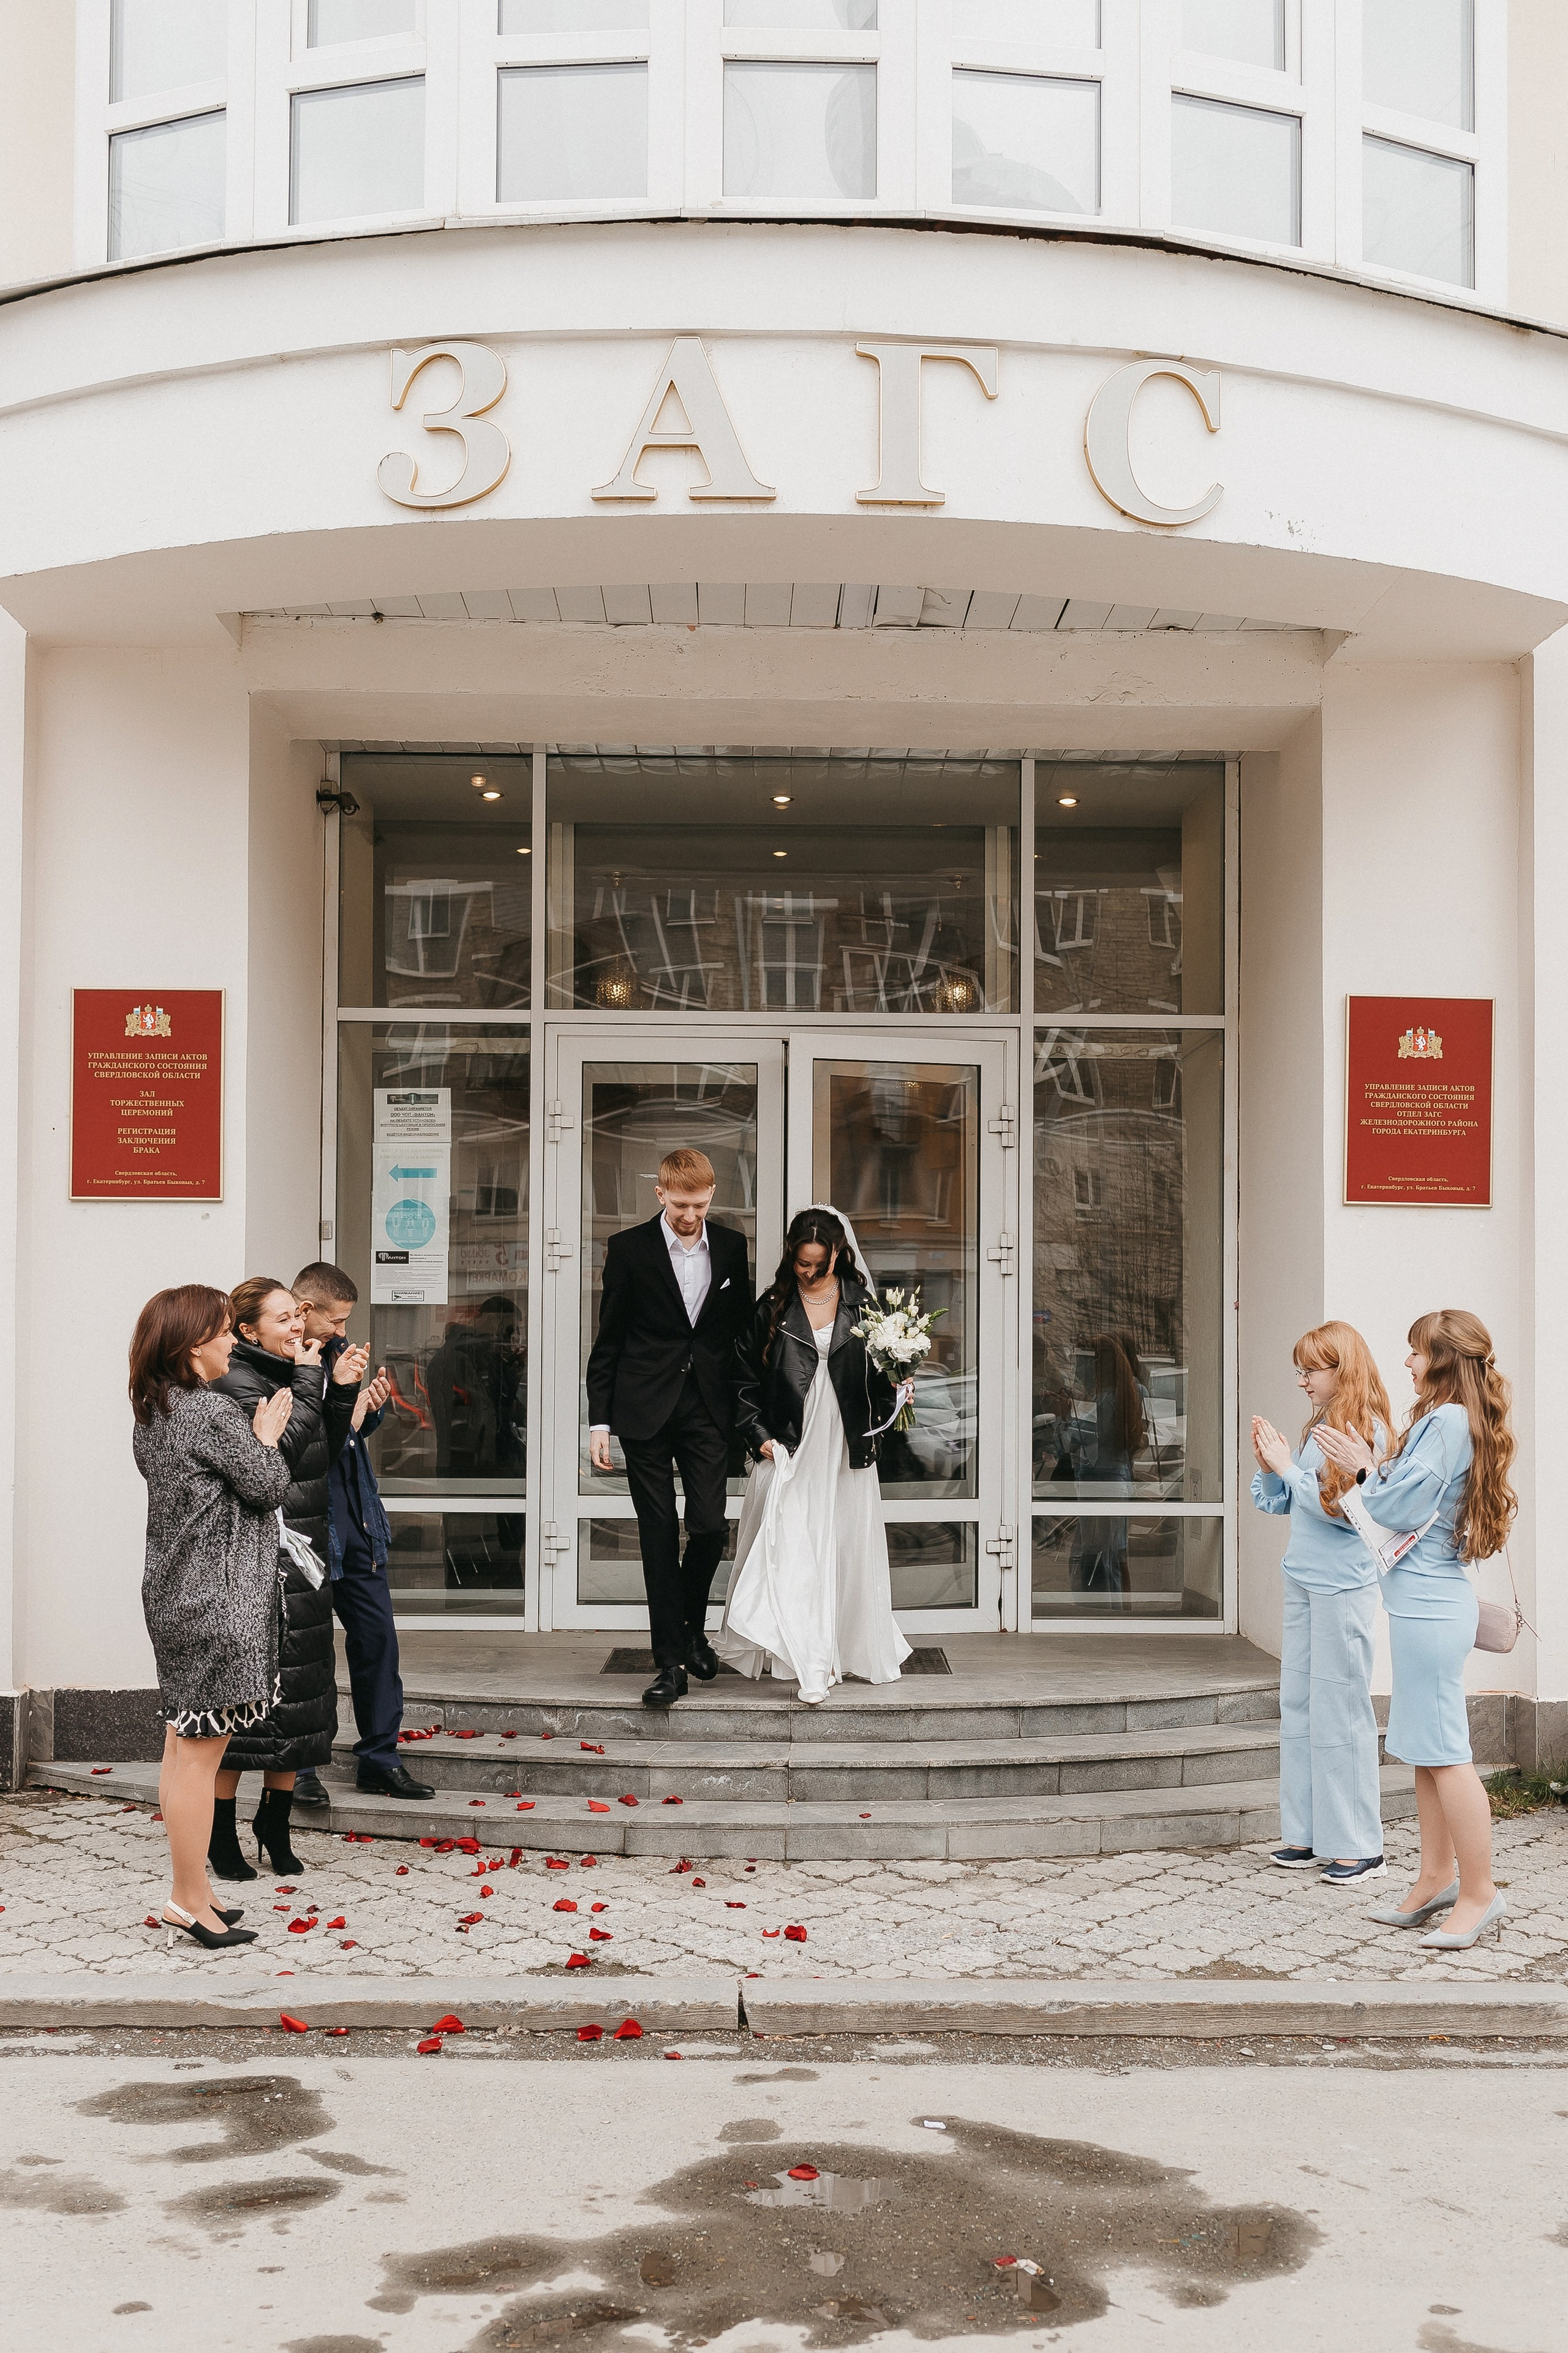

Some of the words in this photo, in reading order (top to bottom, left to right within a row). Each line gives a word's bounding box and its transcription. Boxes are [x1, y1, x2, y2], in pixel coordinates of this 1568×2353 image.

[376, 336, 1224, 527] ЗАГС
[94, 1070, 160, 1079] СВЕРДЛОВСКОЙ
[1370, 1100, 1431, 1109] СВЕРДЛОВСКОЙ
[121, 1108, 173, 1117] ЦЕРЕМОНИЙ
[1447, 1119, 1479, 1127] РАЙОНА
